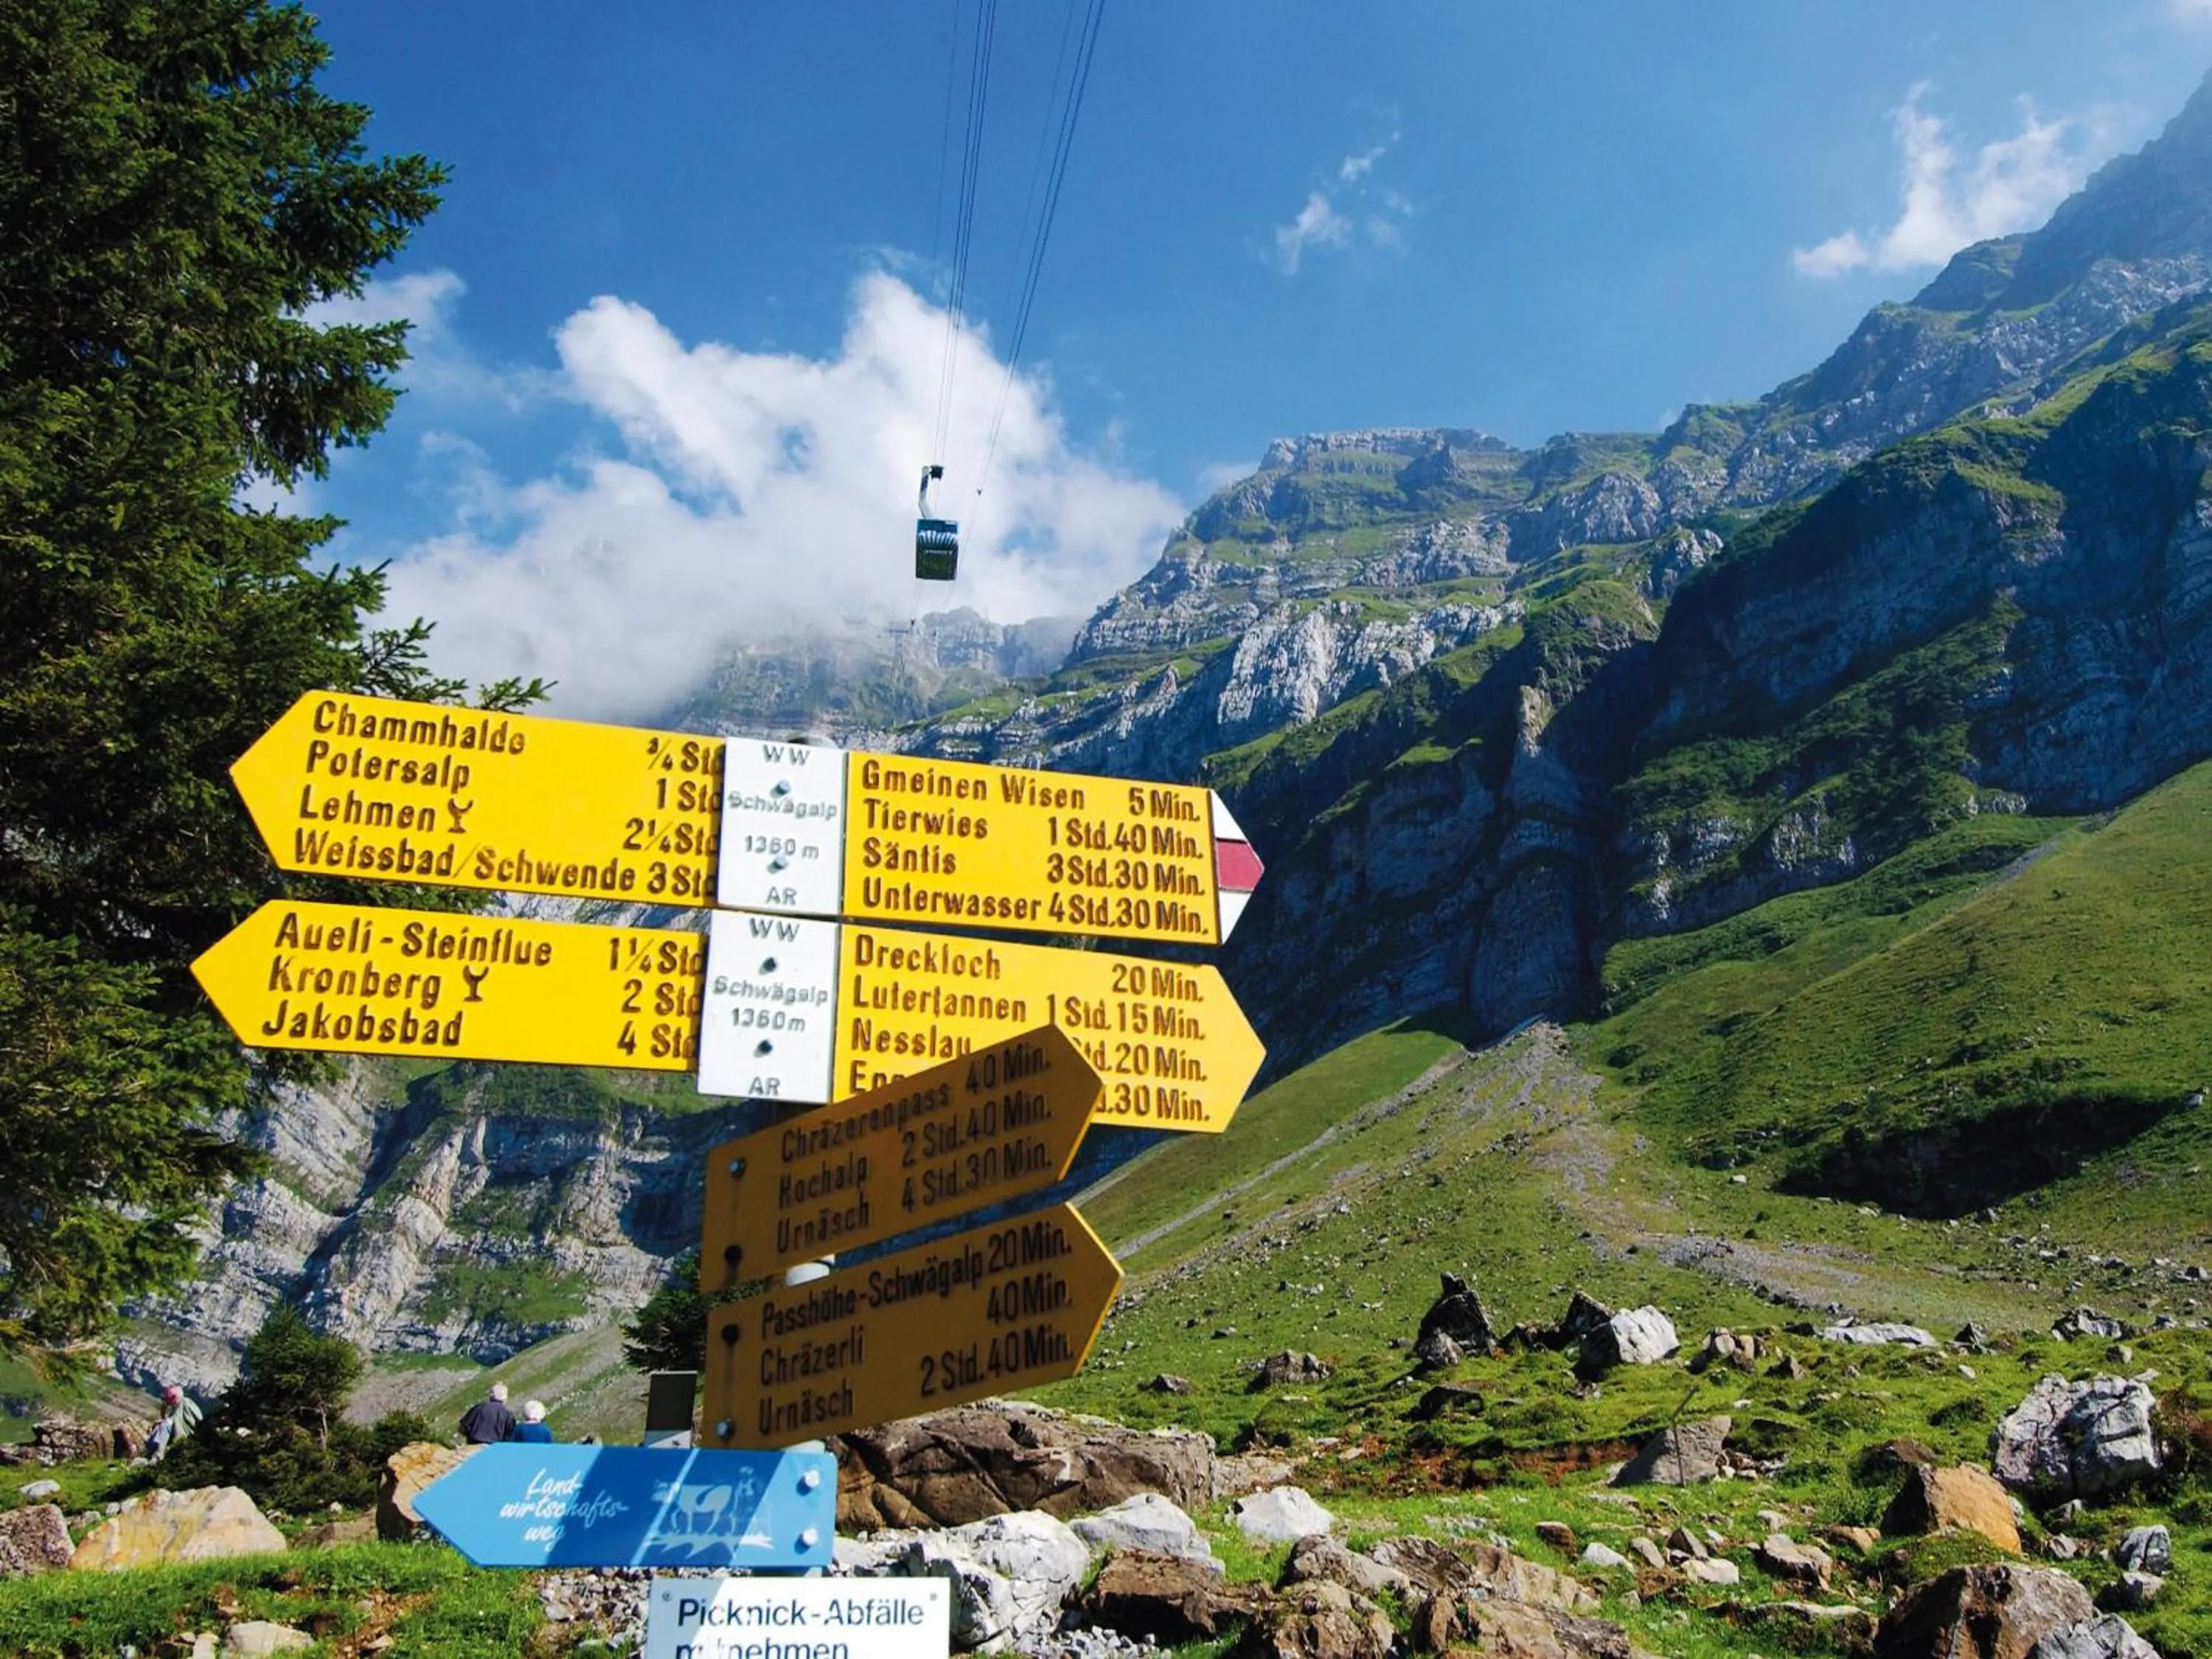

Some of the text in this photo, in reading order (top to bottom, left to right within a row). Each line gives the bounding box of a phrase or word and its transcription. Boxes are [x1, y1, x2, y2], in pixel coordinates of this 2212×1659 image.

[313, 700, 526, 755] Chammhalde
[306, 740, 470, 794] Potersalp
[656, 778, 667, 810] 1
[862, 759, 1200, 822] Gmeinen Wisen 5 Min.
[299, 784, 436, 832] Lehmen
[863, 798, 988, 839] Tierwies
[1048, 815, 1057, 846] 1
[1151, 824, 1203, 859] Min.
[647, 860, 667, 894] 3
[765, 886, 797, 905] AR
[863, 836, 956, 874] Säntis
[1153, 862, 1206, 896] Min.
[863, 875, 1042, 921] Unterwasser
[1155, 900, 1208, 935] Min.
[268, 954, 442, 1010] Kronberg
[621, 978, 643, 1013] 2
[712, 975, 828, 1007] Schwägalp
[855, 933, 1204, 1002] Dreckloch 20 Min.
[261, 998, 463, 1047] Jakobsbad
[616, 1020, 637, 1057] 4
[852, 973, 1026, 1023] Lutertannen
[1046, 993, 1056, 1025] 1
[1152, 1004, 1206, 1040] Min.
[851, 1017, 971, 1058] Nesslau
[1154, 1046, 1208, 1082] Min.
[748, 1076, 781, 1096] AR
[781, 1042, 1051, 1163] Chräzerenpass 40 Min.
[1155, 1086, 1210, 1121] Min.
[902, 1130, 916, 1168] 2
[1003, 1089, 1052, 1131] Min.
[776, 1192, 870, 1253] Urnäsch
[901, 1177, 915, 1214] 4
[1003, 1136, 1052, 1178] Min.
[760, 1326, 864, 1386] Chräzerli
[758, 1377, 855, 1436] Urnäsch
[524, 1467, 584, 1500] Land-
[524, 1524, 566, 1553] weg
[677, 1598, 925, 1627] Picknick-Abfälle
[675, 1637, 849, 1659] mnehmen
